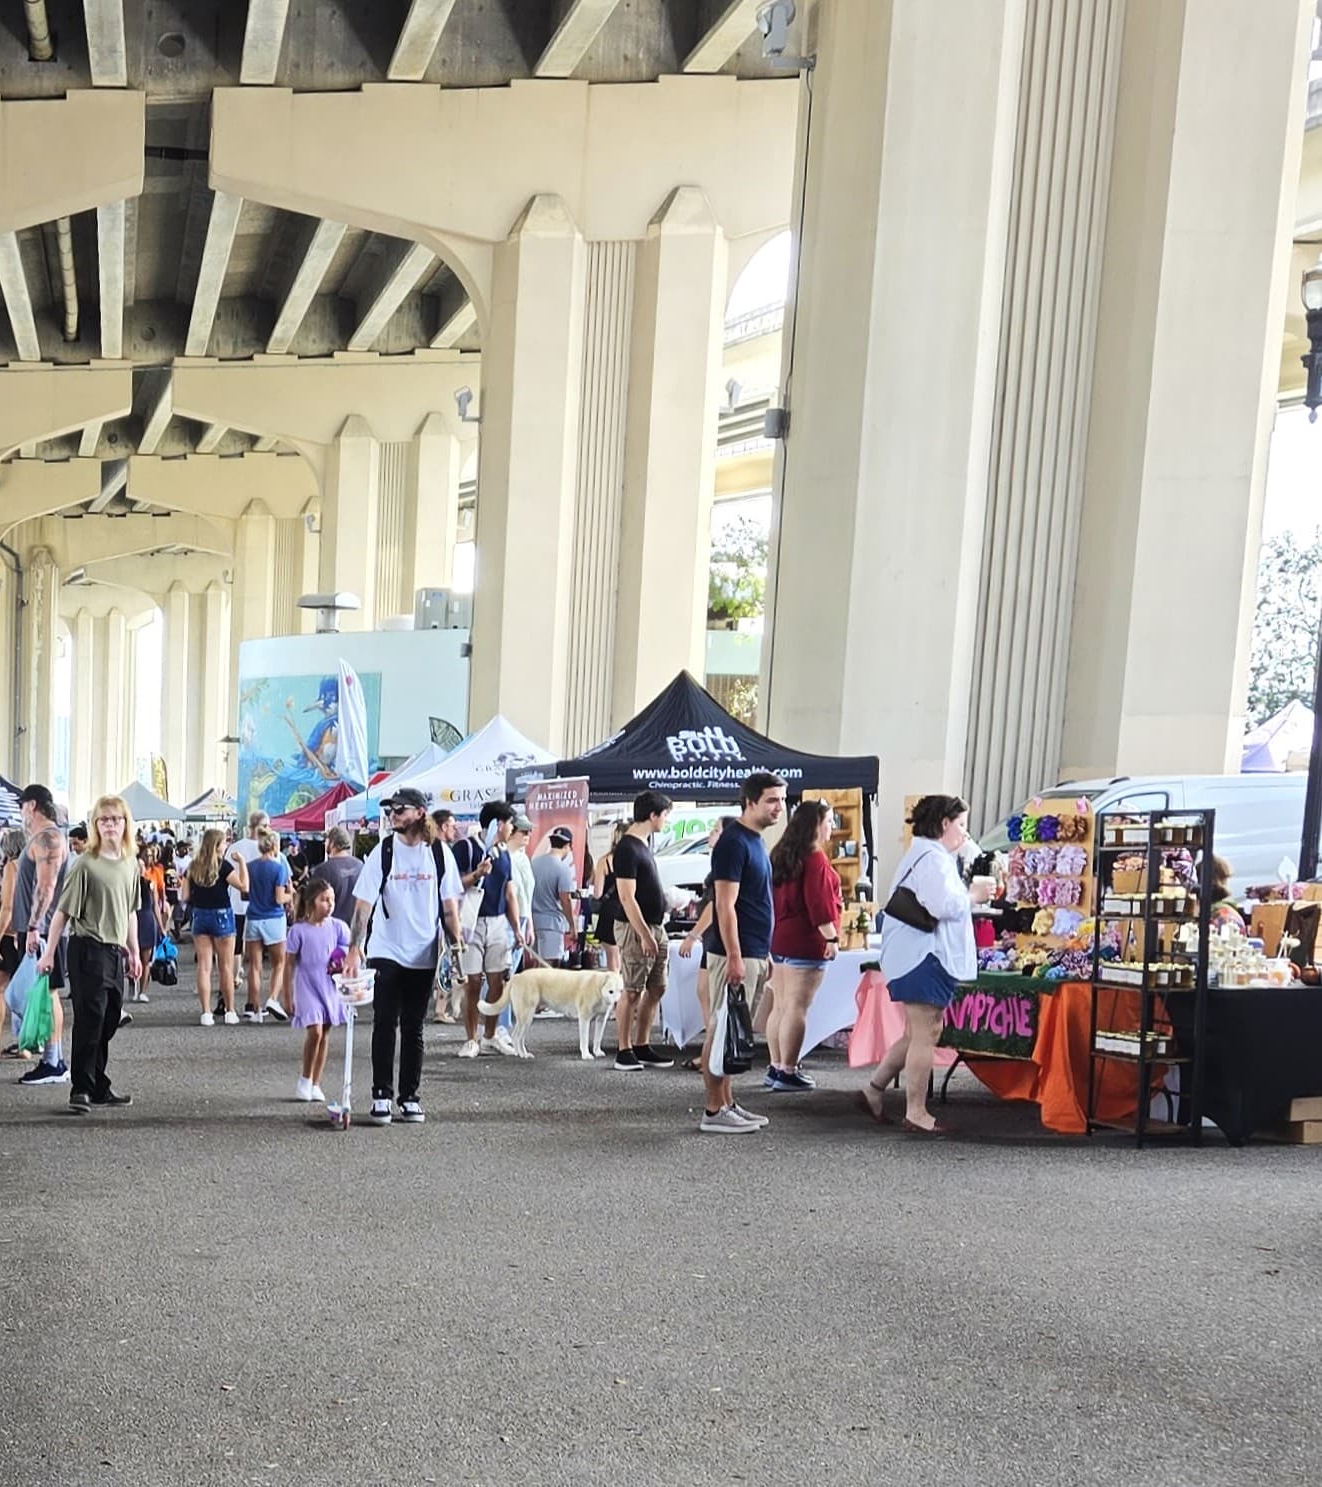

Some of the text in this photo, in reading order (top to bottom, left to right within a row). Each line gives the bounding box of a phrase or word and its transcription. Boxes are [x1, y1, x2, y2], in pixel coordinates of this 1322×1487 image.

[648, 781, 705, 789] Chiropractic.
[449, 789, 496, 802] GRAS
[537, 790, 578, 801] MAXIMIZED
[557, 799, 584, 809] SUPPLY
